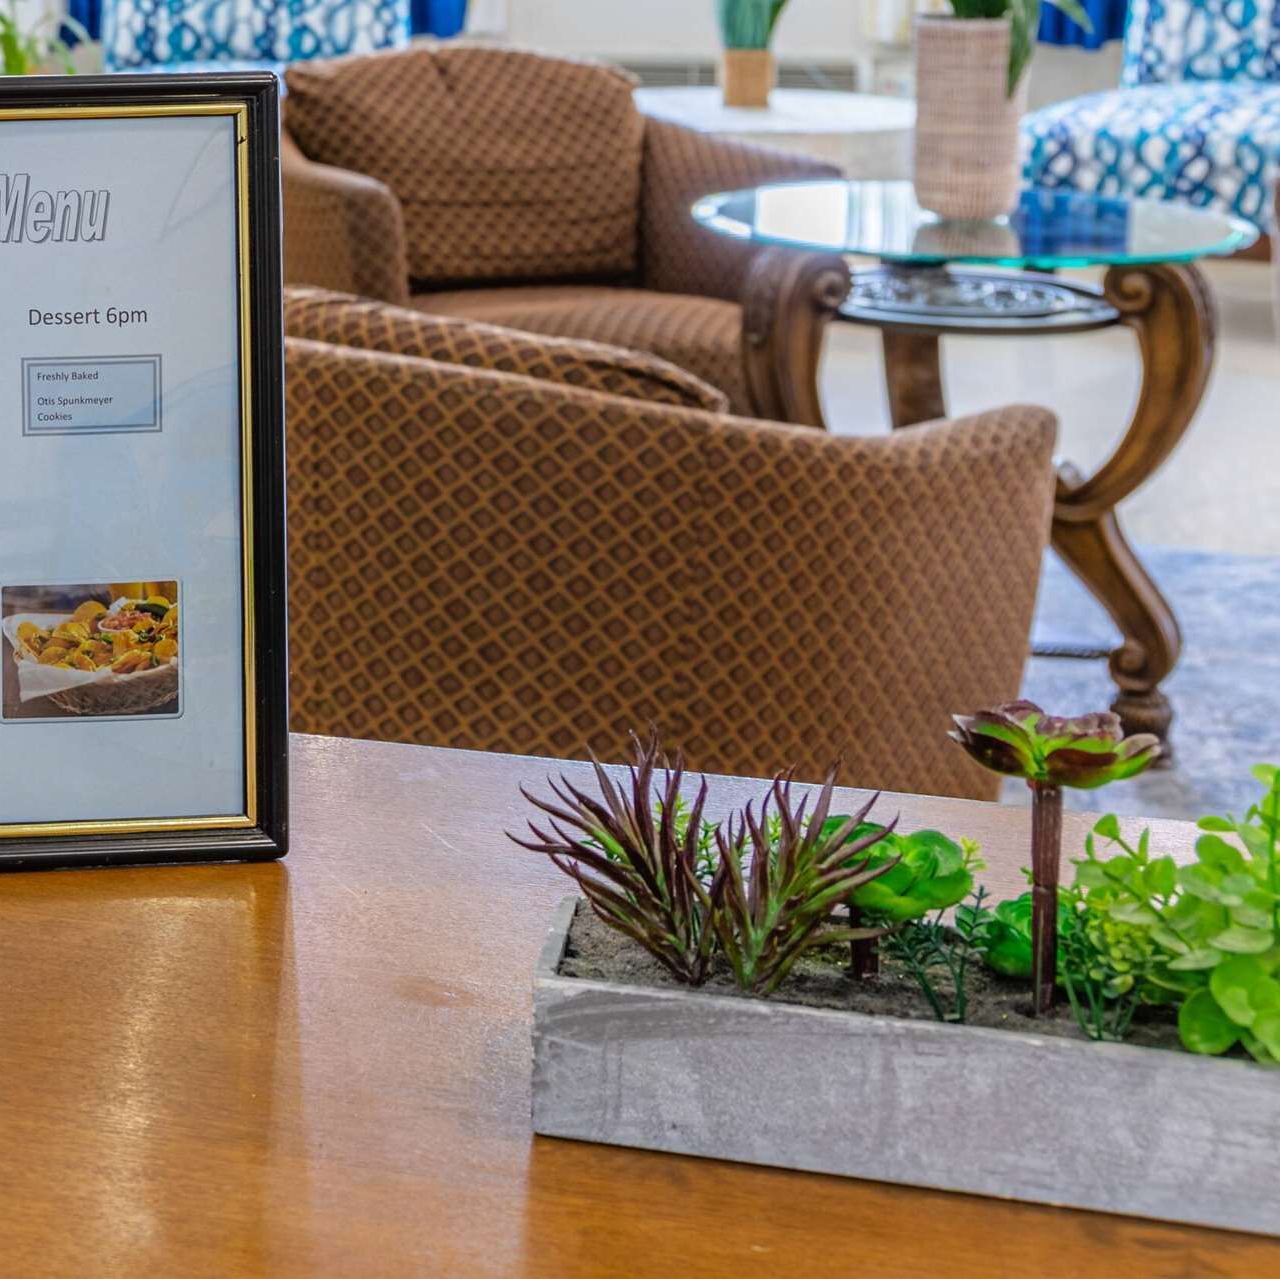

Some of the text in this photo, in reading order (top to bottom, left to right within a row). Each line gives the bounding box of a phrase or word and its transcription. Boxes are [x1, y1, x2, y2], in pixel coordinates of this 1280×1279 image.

[28, 306, 148, 328] Dessert 6pm
[37, 371, 99, 382] Freshly Baked
[37, 395, 114, 407] Otis Spunkmeyer
[37, 412, 73, 421] Cookies
